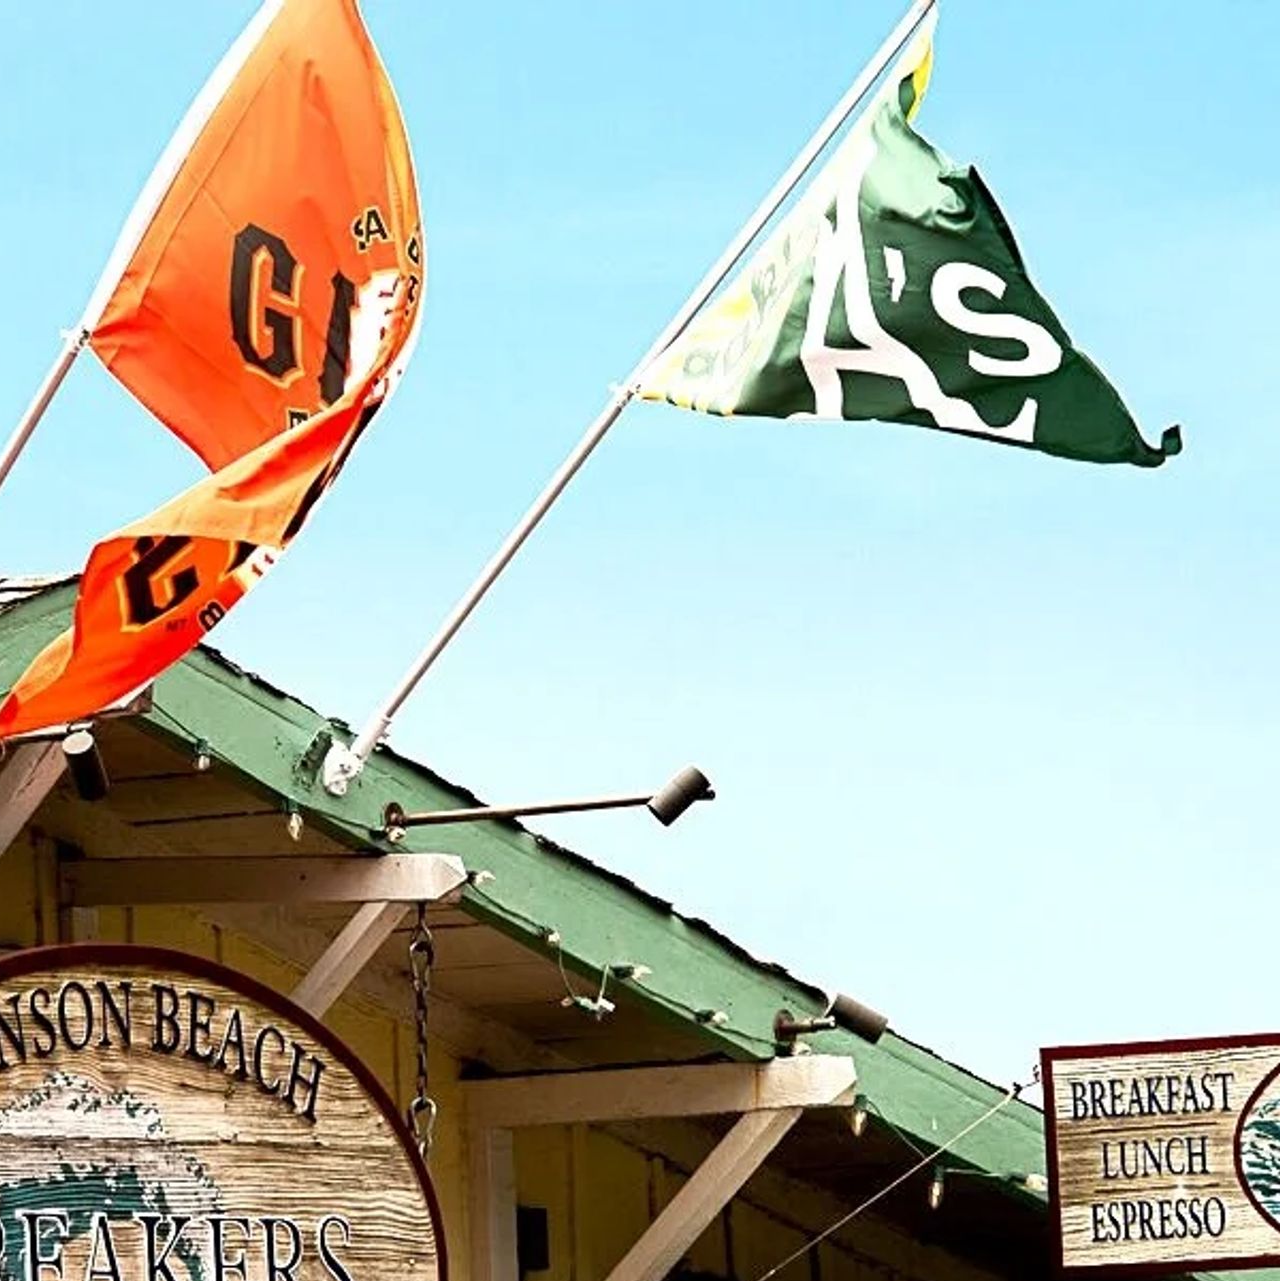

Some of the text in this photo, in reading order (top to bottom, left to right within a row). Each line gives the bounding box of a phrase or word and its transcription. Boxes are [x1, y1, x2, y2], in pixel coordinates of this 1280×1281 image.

[151, 982, 325, 1123] BEACH
[1071, 1073, 1234, 1120] BREAKFAST
[1102, 1136, 1210, 1179] LUNCH
[1092, 1198, 1226, 1243] ESPRESSO
